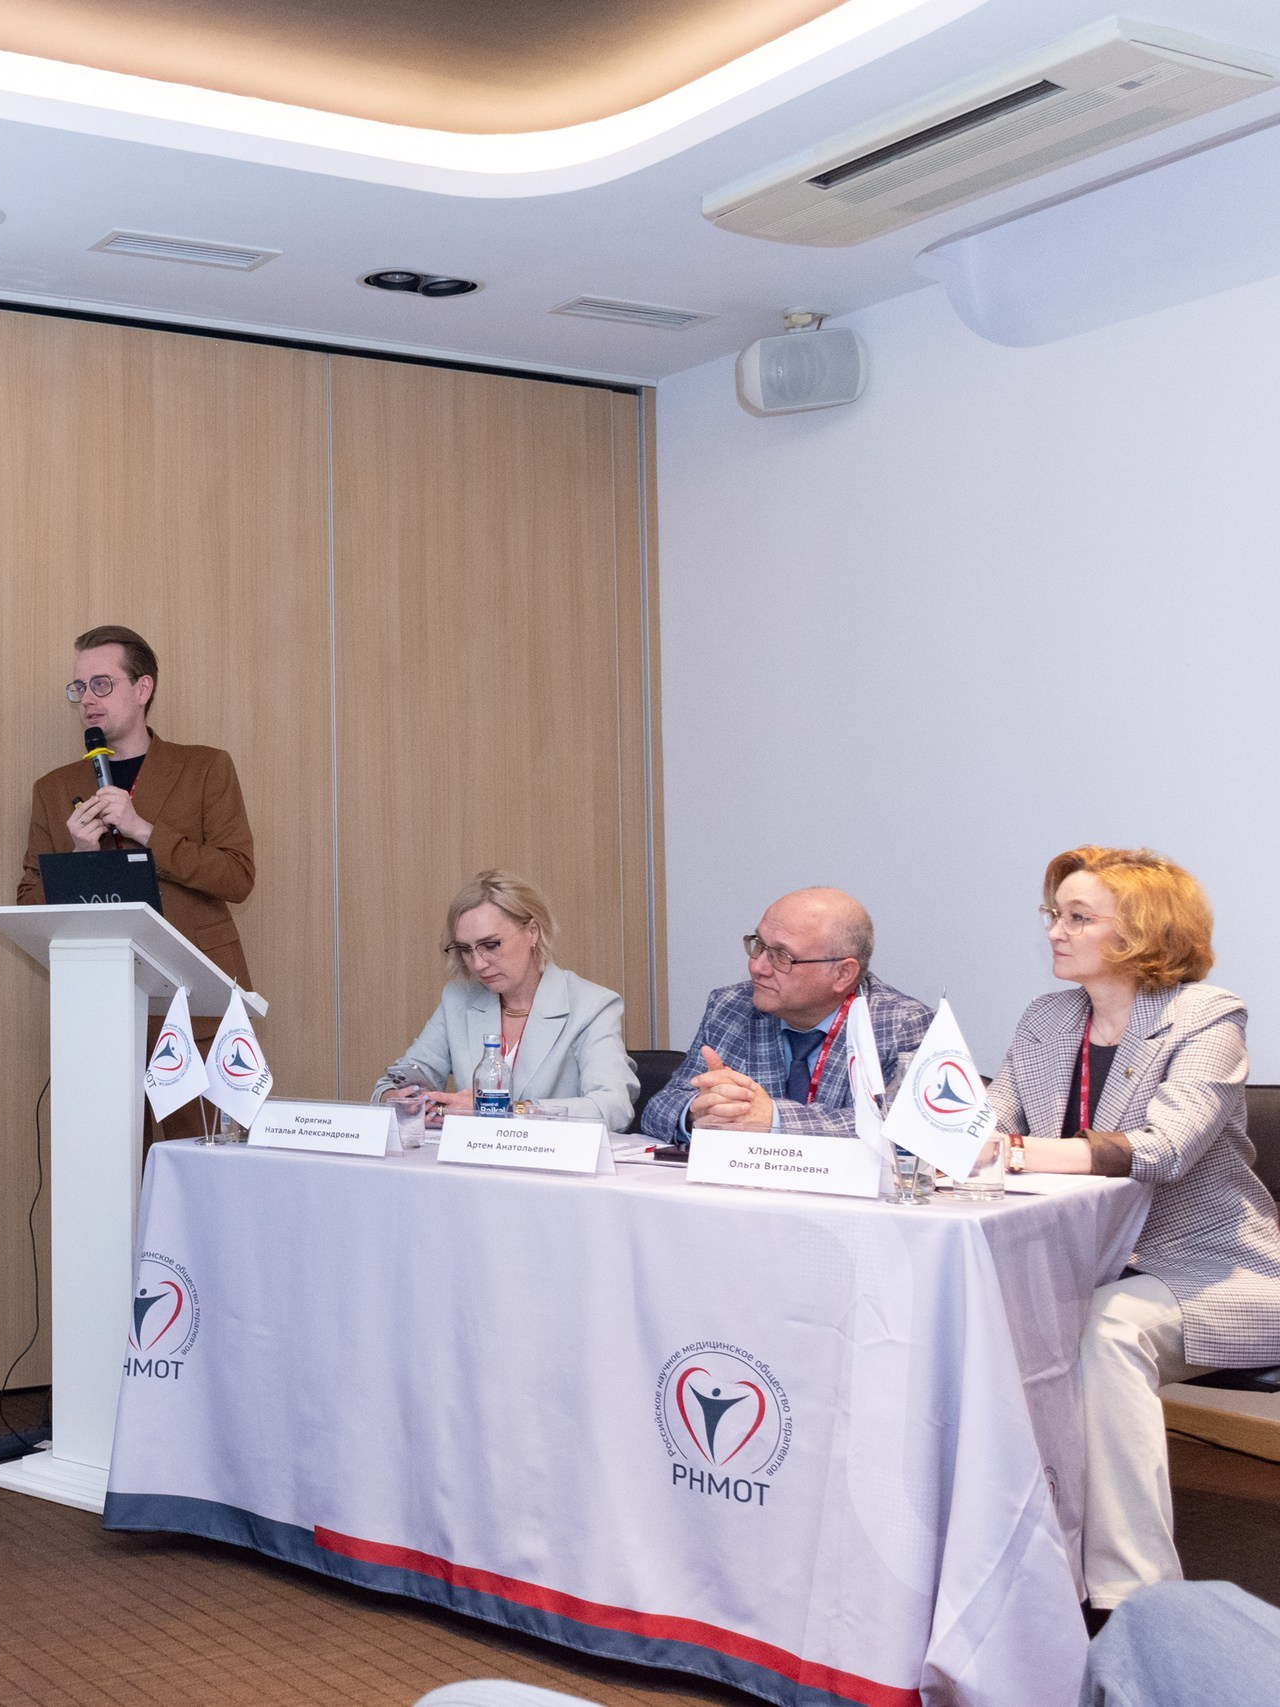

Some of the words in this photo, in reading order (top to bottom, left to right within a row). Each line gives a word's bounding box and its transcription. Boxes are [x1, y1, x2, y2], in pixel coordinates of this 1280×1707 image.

[294, 1116, 332, 1125] Корягина
[265, 1126, 296, 1135] Наталья
[298, 1128, 360, 1139] Александровна
[496, 1129, 529, 1139] ПОПОВ
[466, 1140, 493, 1150] Артем
[495, 1143, 555, 1153] Анатольевич
[747, 1146, 803, 1158] ХЛЫНОВА
[729, 1160, 760, 1170] Ольга
[764, 1162, 829, 1174] Витальевна
[175, 1264, 199, 1305] общество
[682, 1340, 754, 1362] медицинское
[656, 1350, 682, 1389] научное
[755, 1360, 791, 1413] общество
[655, 1390, 676, 1457] Российское
[766, 1416, 792, 1477] терапевтов
[672, 1462, 770, 1506] РНМОТ
